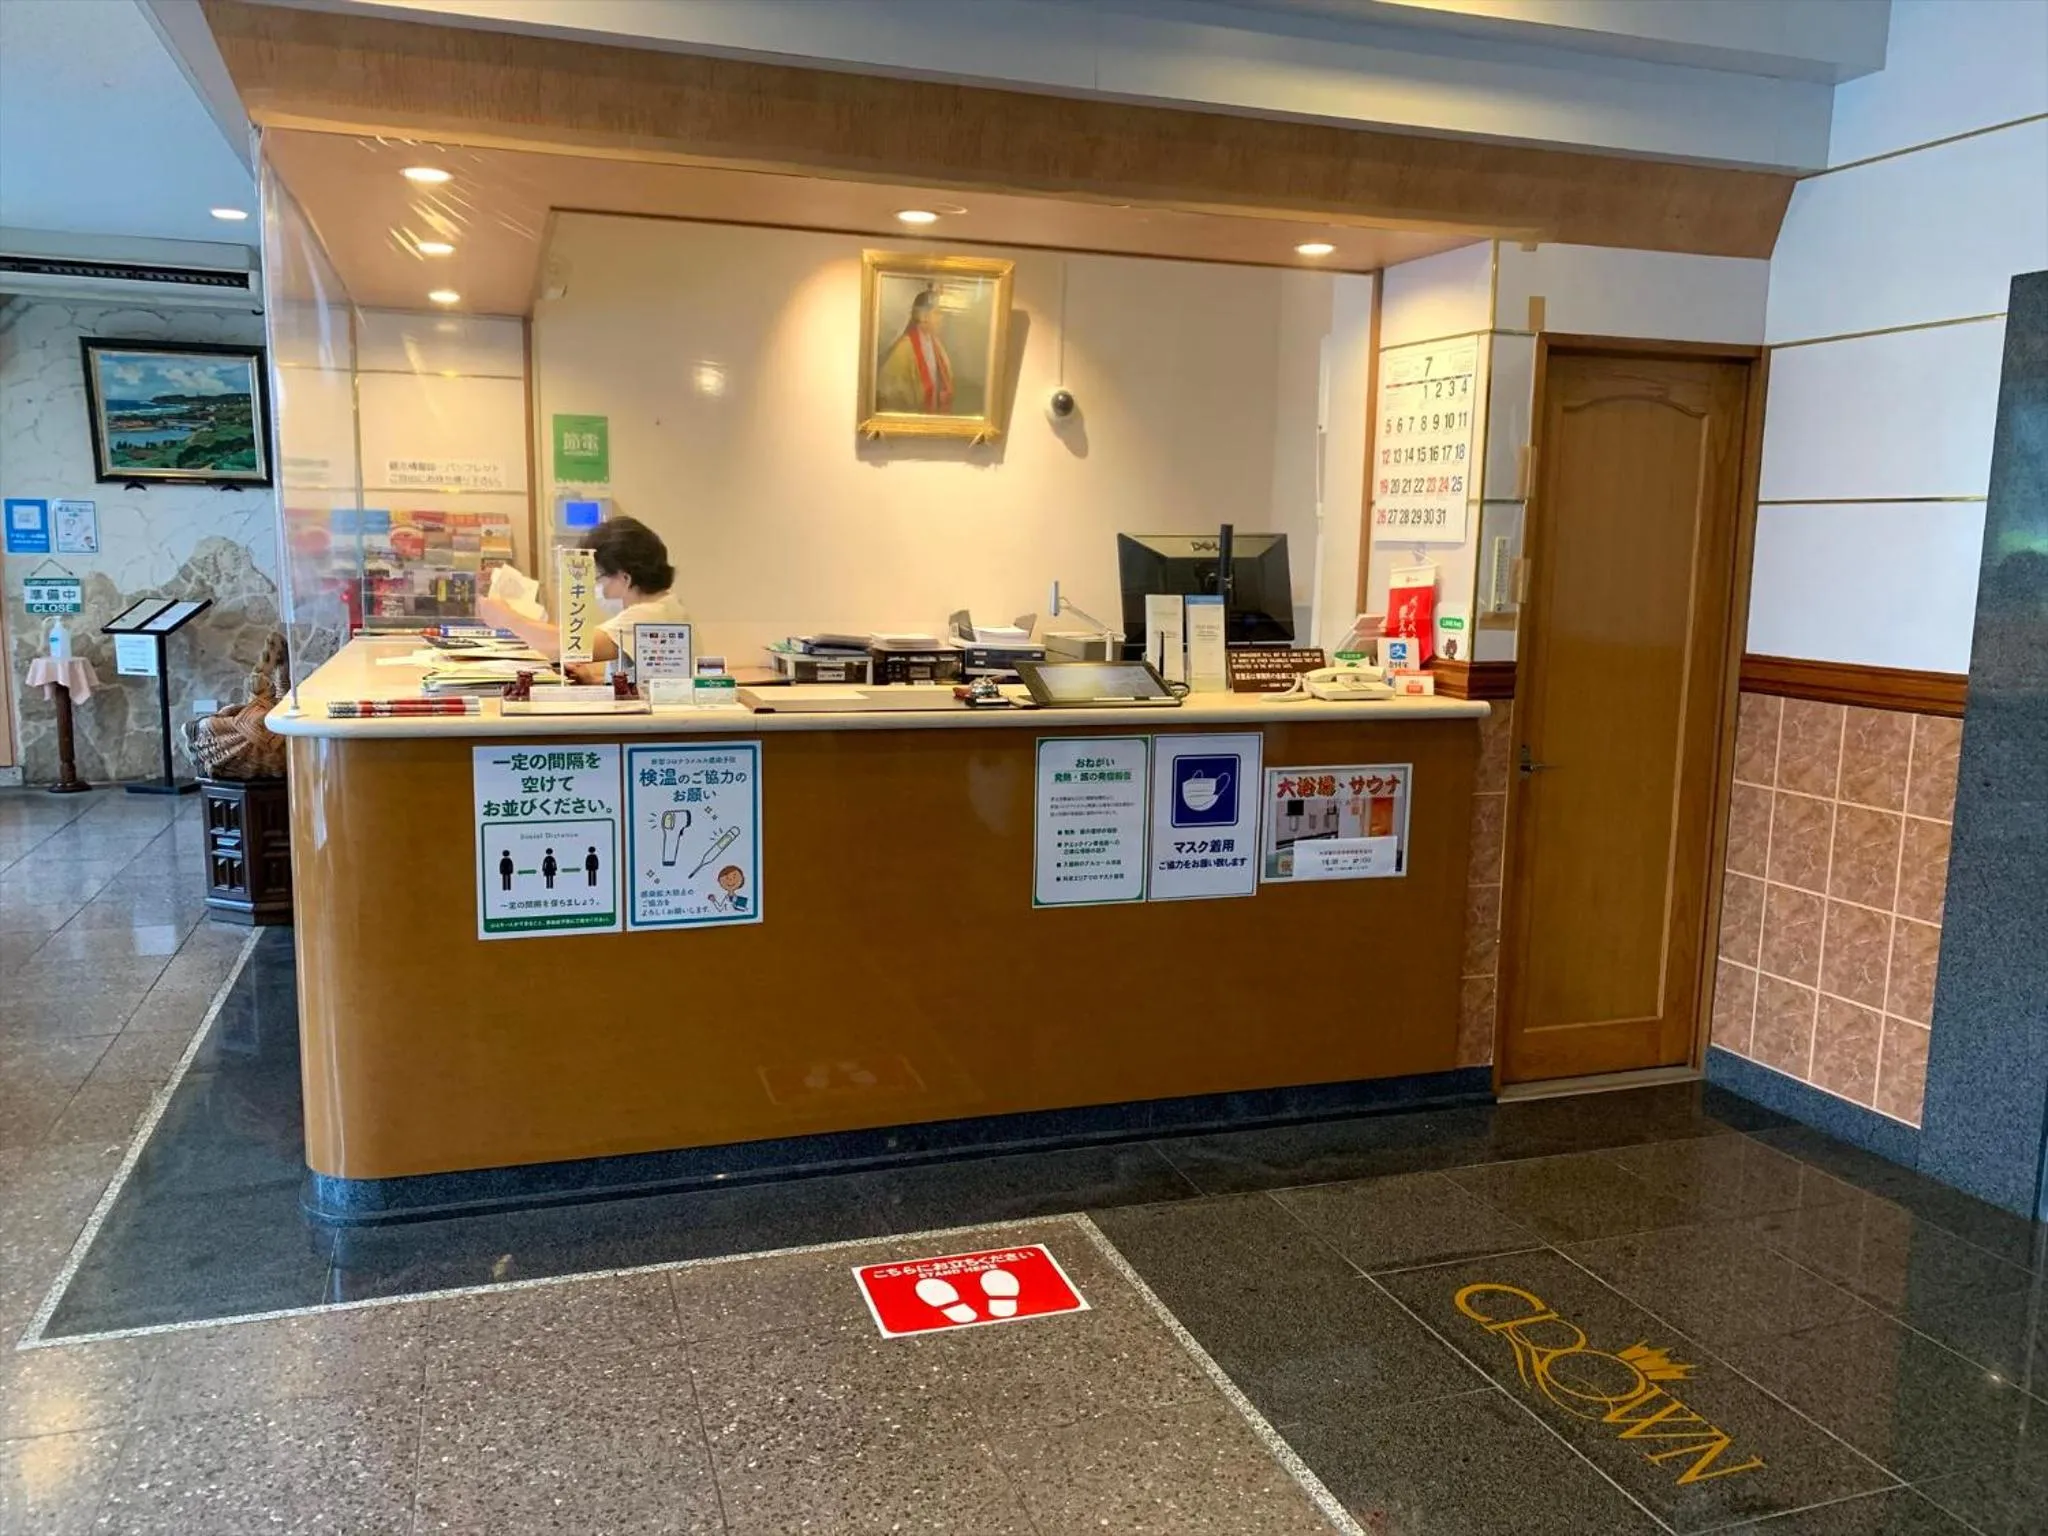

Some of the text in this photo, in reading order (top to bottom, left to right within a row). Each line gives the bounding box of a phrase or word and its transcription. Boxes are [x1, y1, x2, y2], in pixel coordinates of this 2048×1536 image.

[1424, 356, 1433, 377] 7
[1424, 378, 1468, 399] 1 2 3 4
[1386, 412, 1468, 434] 5 6 7 8 9 10 11
[1382, 444, 1465, 465] 12 13 14 15 16 17 18
[1380, 476, 1463, 495] 19 20 21 22 23 24 25
[1377, 510, 1446, 525] 26 27 28 29 30 31
[30, 589, 76, 600] 準備中
[33, 604, 73, 613] CLOSE
[493, 752, 601, 771] 一定の間隔を
[1075, 758, 1114, 768] おねがい
[521, 776, 574, 793] 空けて
[639, 768, 747, 787] 検温のご協力の
[1277, 774, 1400, 798] 大浴場・サウナ
[673, 788, 717, 802] お願い
[483, 799, 612, 817] お並びください。
[1173, 839, 1235, 854] マスク着用
[1158, 857, 1248, 871] ご協力をお願い致します
[500, 898, 600, 909] 一定の間隔を保ちましょう。
[873, 1251, 1036, 1279] こちらにお立ちください
[918, 1264, 998, 1279] STAND HERE
[1454, 1282, 1767, 1485] CROWN
